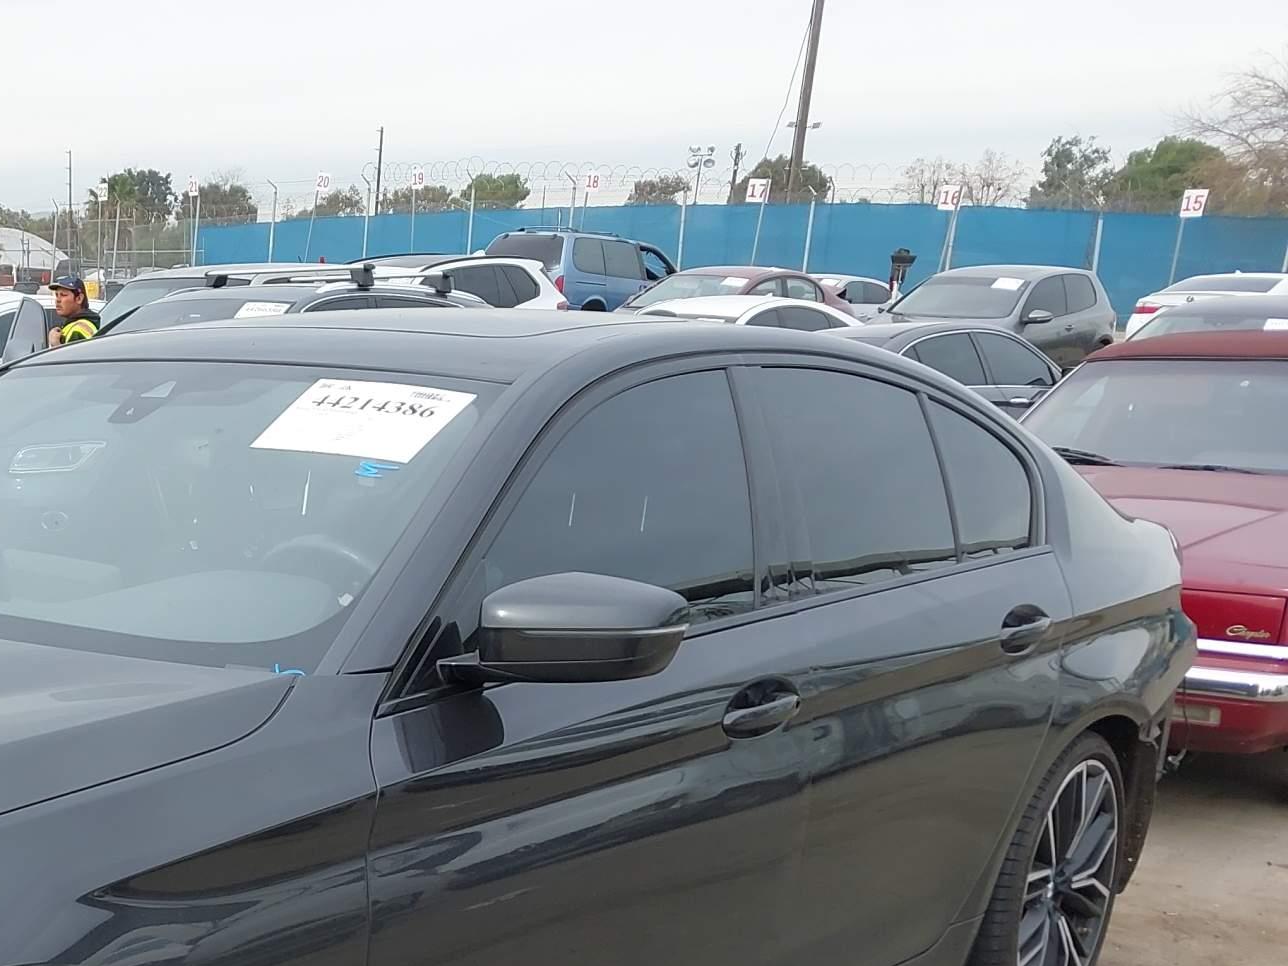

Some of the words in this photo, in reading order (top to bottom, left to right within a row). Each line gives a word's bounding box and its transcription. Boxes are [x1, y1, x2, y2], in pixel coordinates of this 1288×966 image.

[316, 175, 330, 188] 20
[412, 172, 424, 186] 19
[586, 175, 599, 188] 18
[189, 180, 198, 193] 21
[747, 183, 767, 198] 17
[1182, 194, 1205, 212] 15
[311, 393, 440, 419] 44214386
